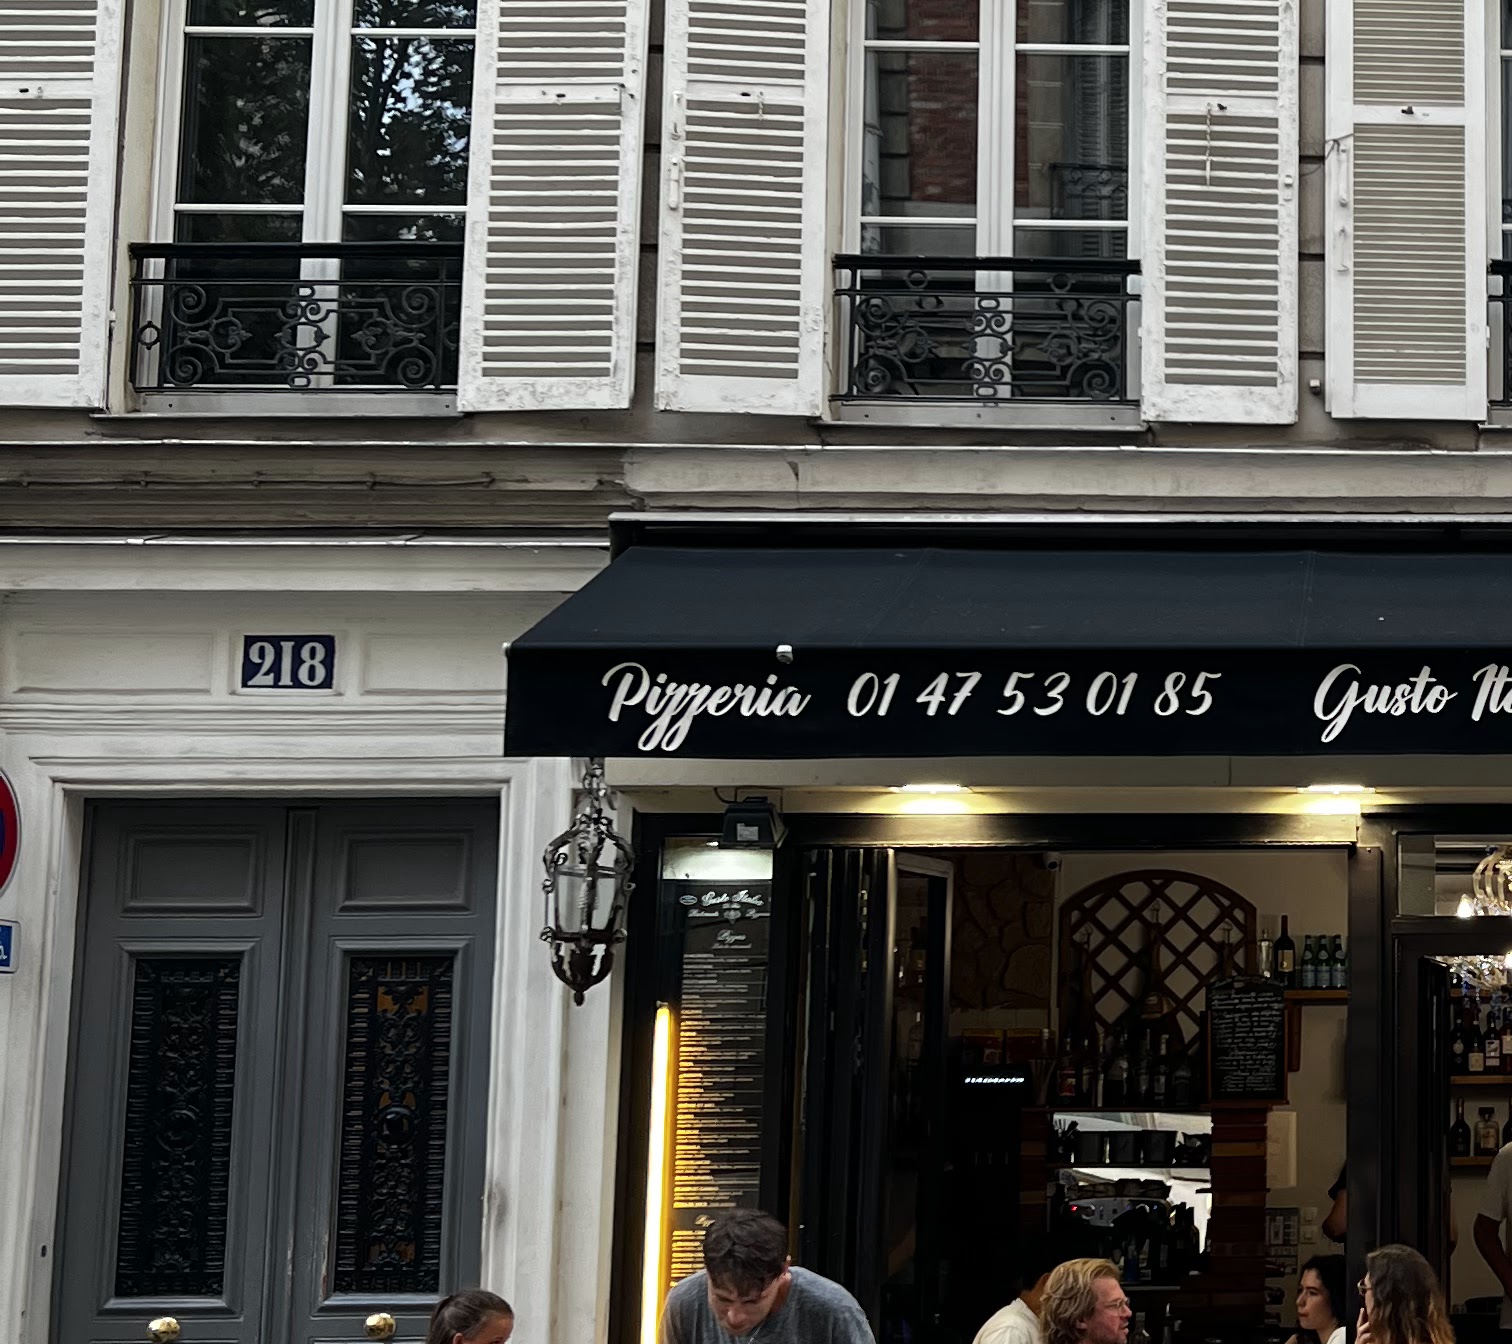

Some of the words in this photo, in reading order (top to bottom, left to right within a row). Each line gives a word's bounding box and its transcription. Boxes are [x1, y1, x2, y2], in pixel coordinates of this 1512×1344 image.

[248, 652, 325, 686] 218
[601, 662, 811, 751] Pizzeria
[847, 671, 901, 717] 01
[915, 671, 982, 717] 47
[996, 671, 1071, 716] 53
[1086, 671, 1138, 716] 01
[1153, 671, 1222, 716] 85
[1313, 663, 1458, 743] Gusto
